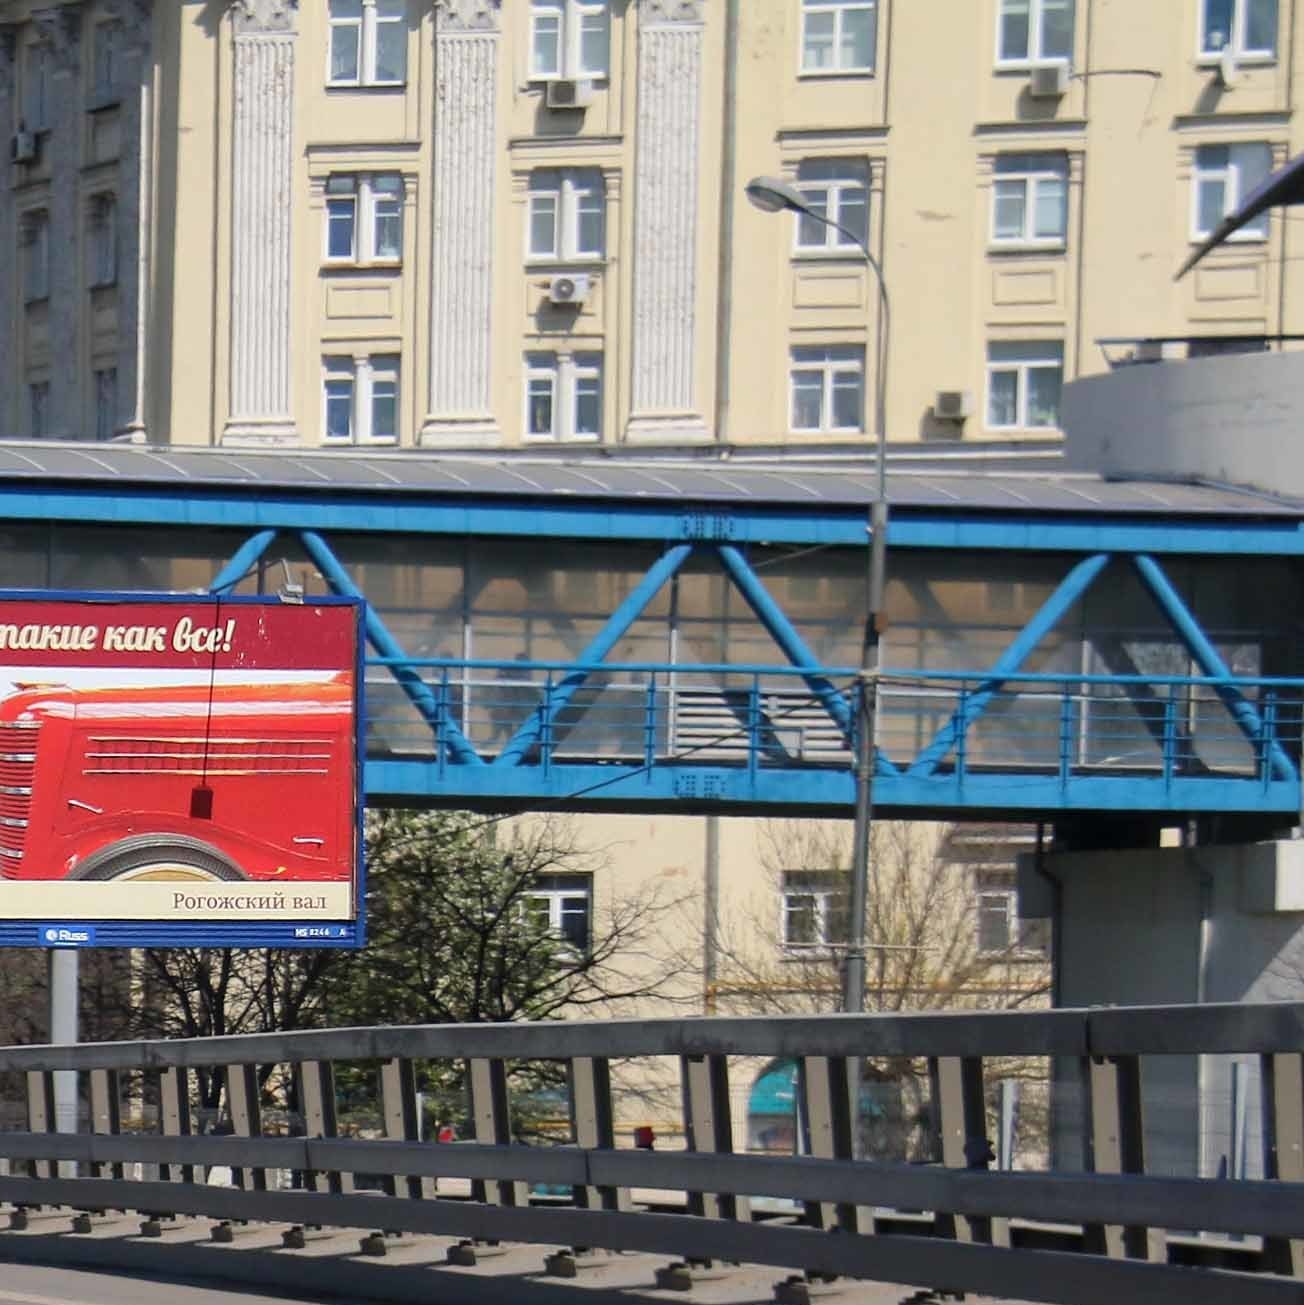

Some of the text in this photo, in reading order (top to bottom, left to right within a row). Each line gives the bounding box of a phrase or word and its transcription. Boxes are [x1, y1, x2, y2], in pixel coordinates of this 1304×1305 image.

[103, 622, 166, 652] как
[172, 616, 236, 653] все!
[173, 892, 327, 909] Рогожский вал
